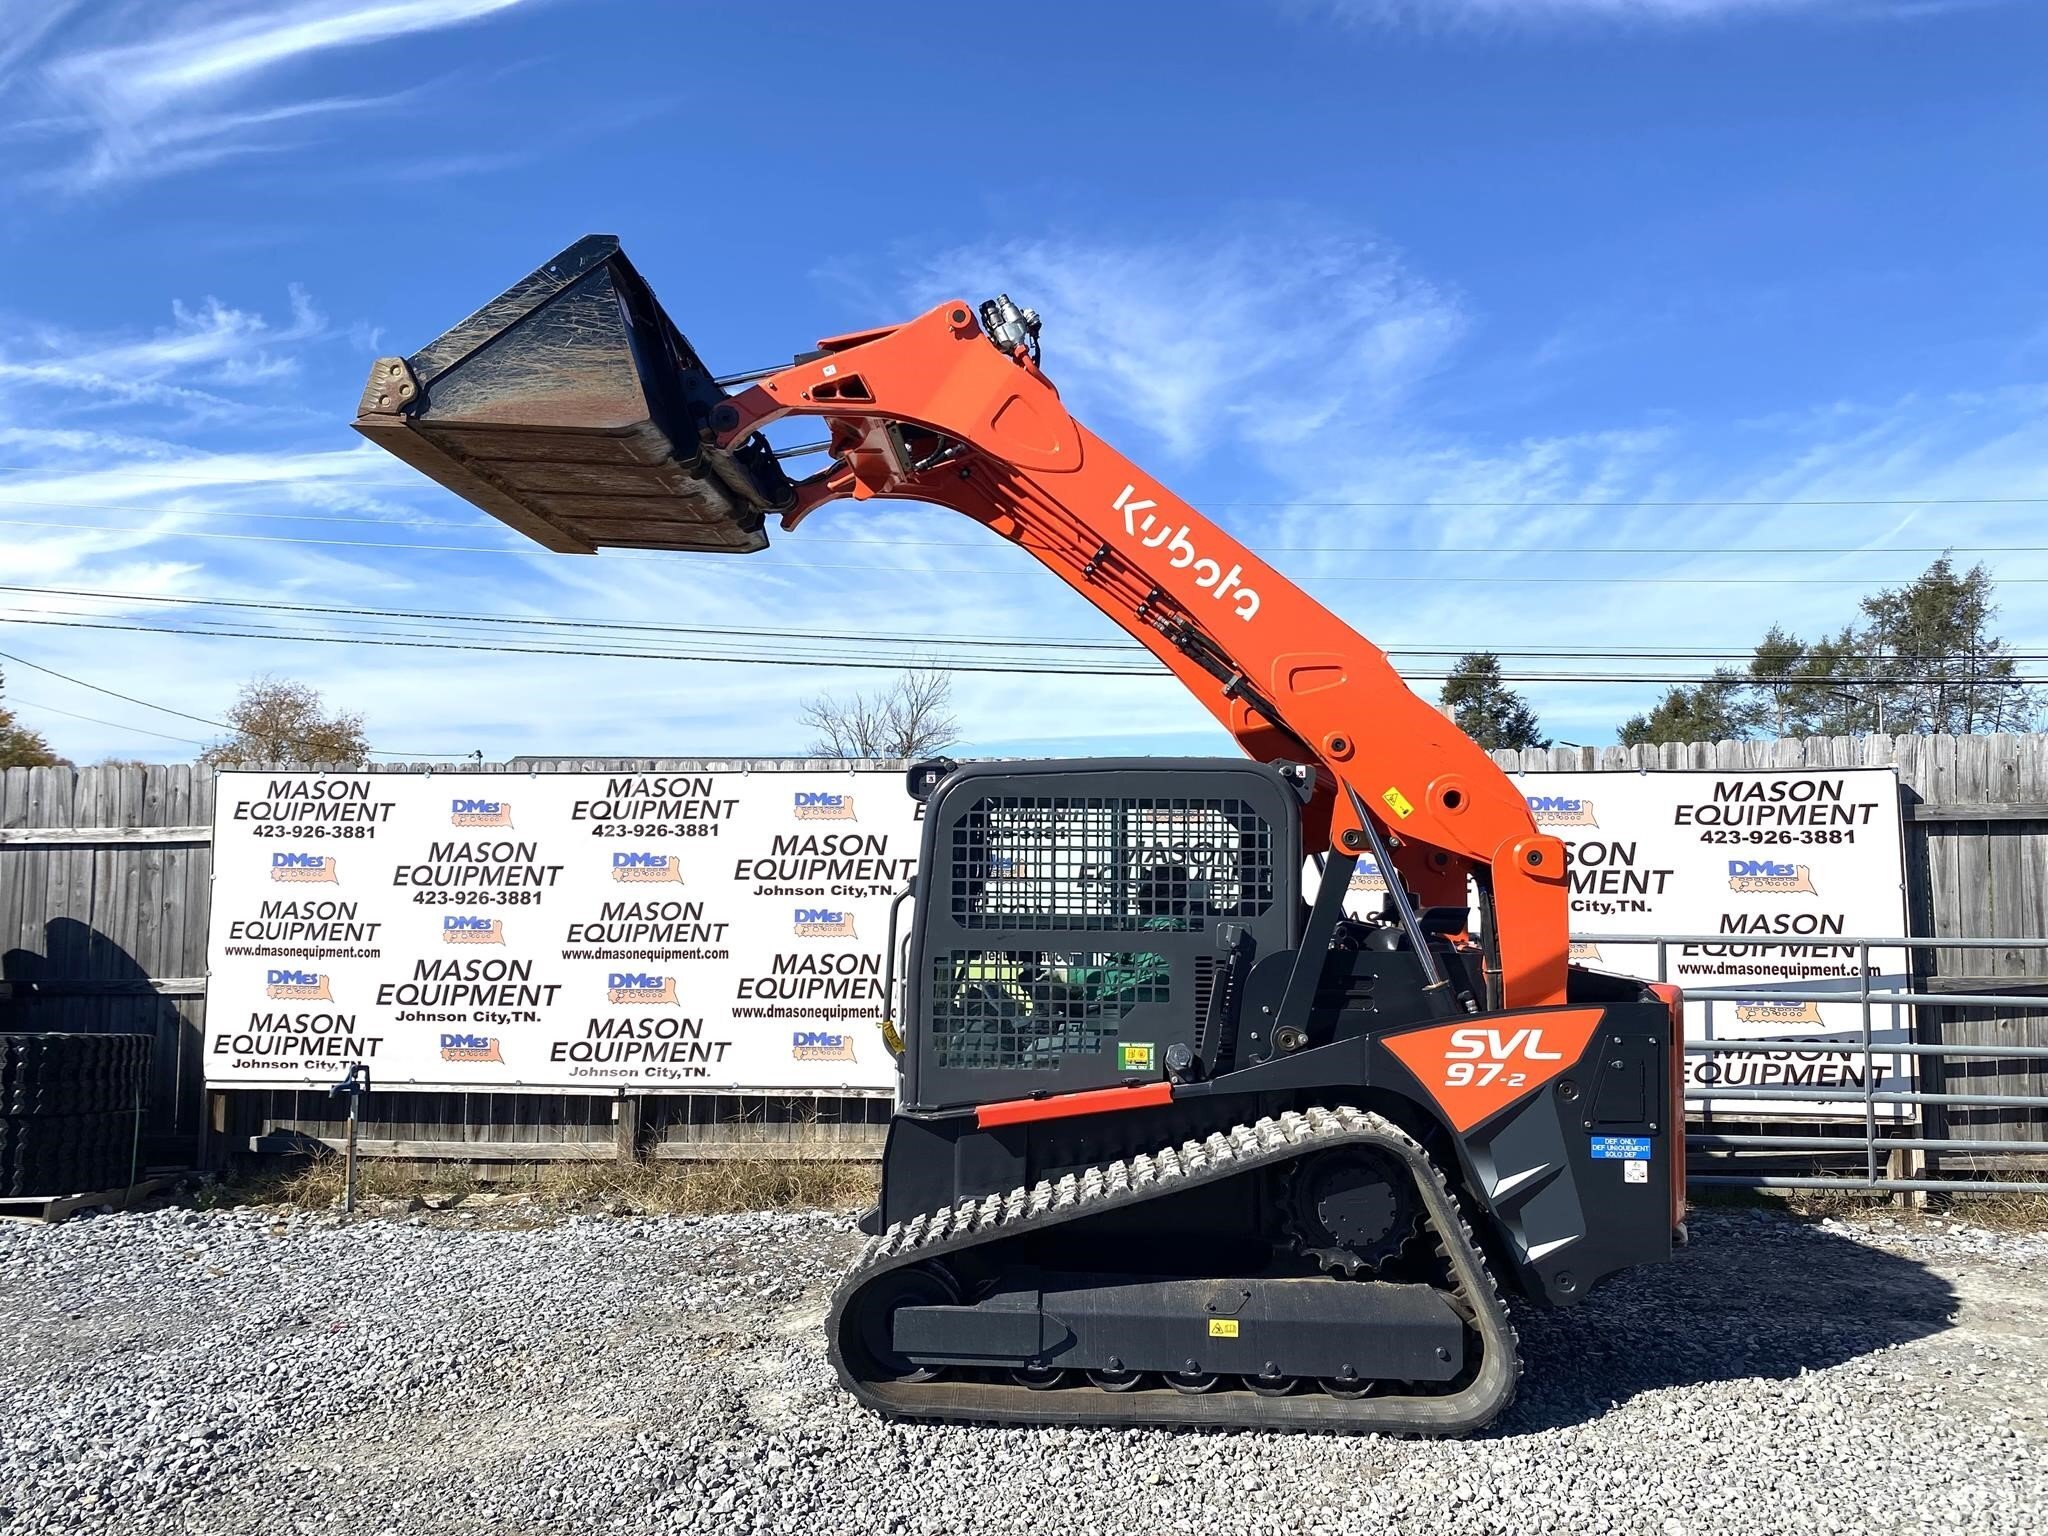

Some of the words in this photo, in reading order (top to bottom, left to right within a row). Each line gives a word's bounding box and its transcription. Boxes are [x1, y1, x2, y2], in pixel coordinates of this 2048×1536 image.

[1112, 484, 1261, 622] Kubota
[267, 781, 370, 800] MASON
[606, 778, 713, 798] MASON
[1713, 780, 1844, 802] MASON
[233, 801, 396, 822] EQUIPMENT
[572, 800, 739, 820] EQUIPMENT
[1674, 803, 1878, 826] EQUIPMENT
[253, 825, 374, 838] 423-926-3881
[592, 824, 718, 837] 423-926-3881
[1700, 830, 1854, 844] 423-926-3881
[428, 842, 537, 863] MASON
[771, 835, 888, 856] MASON
[393, 865, 564, 886] EQUIPMENT
[734, 858, 917, 881] EQUIPMENT
[413, 891, 541, 905] 423-926-3881
[753, 885, 824, 895] Johnson
[830, 885, 897, 898] City,TN.
[260, 901, 358, 920] MASON
[600, 902, 704, 921] MASON
[1570, 900, 1653, 915] City,TN.
[229, 921, 381, 941] EQUIPMENT
[567, 923, 729, 943] EQUIPMENT
[1720, 914, 1844, 934] MASON
[225, 944, 380, 960] www.dmasonequipment.com
[562, 947, 728, 962] www.dmasonequipment.com
[413, 959, 532, 981] MASON
[772, 954, 881, 975] MASON
[1678, 962, 1881, 980] www.dmasonequipment.cm
[376, 984, 562, 1006] EQUIPMENT
[737, 977, 896, 999] EQUIPMEN
[248, 1013, 356, 1034] MASON
[395, 1011, 466, 1022] Johnson
[473, 1011, 541, 1024] City,TN.
[587, 1018, 703, 1039] MASON
[213, 1034, 383, 1057] EQUIPMENT
[550, 1042, 732, 1062] EQUIPMENT
[1444, 1029, 1562, 1060] SVL
[232, 1059, 298, 1069] Johnson
[569, 1067, 638, 1077] Johnson
[645, 1067, 710, 1079] City,TN.
[1444, 1062, 1526, 1087] 97-2
